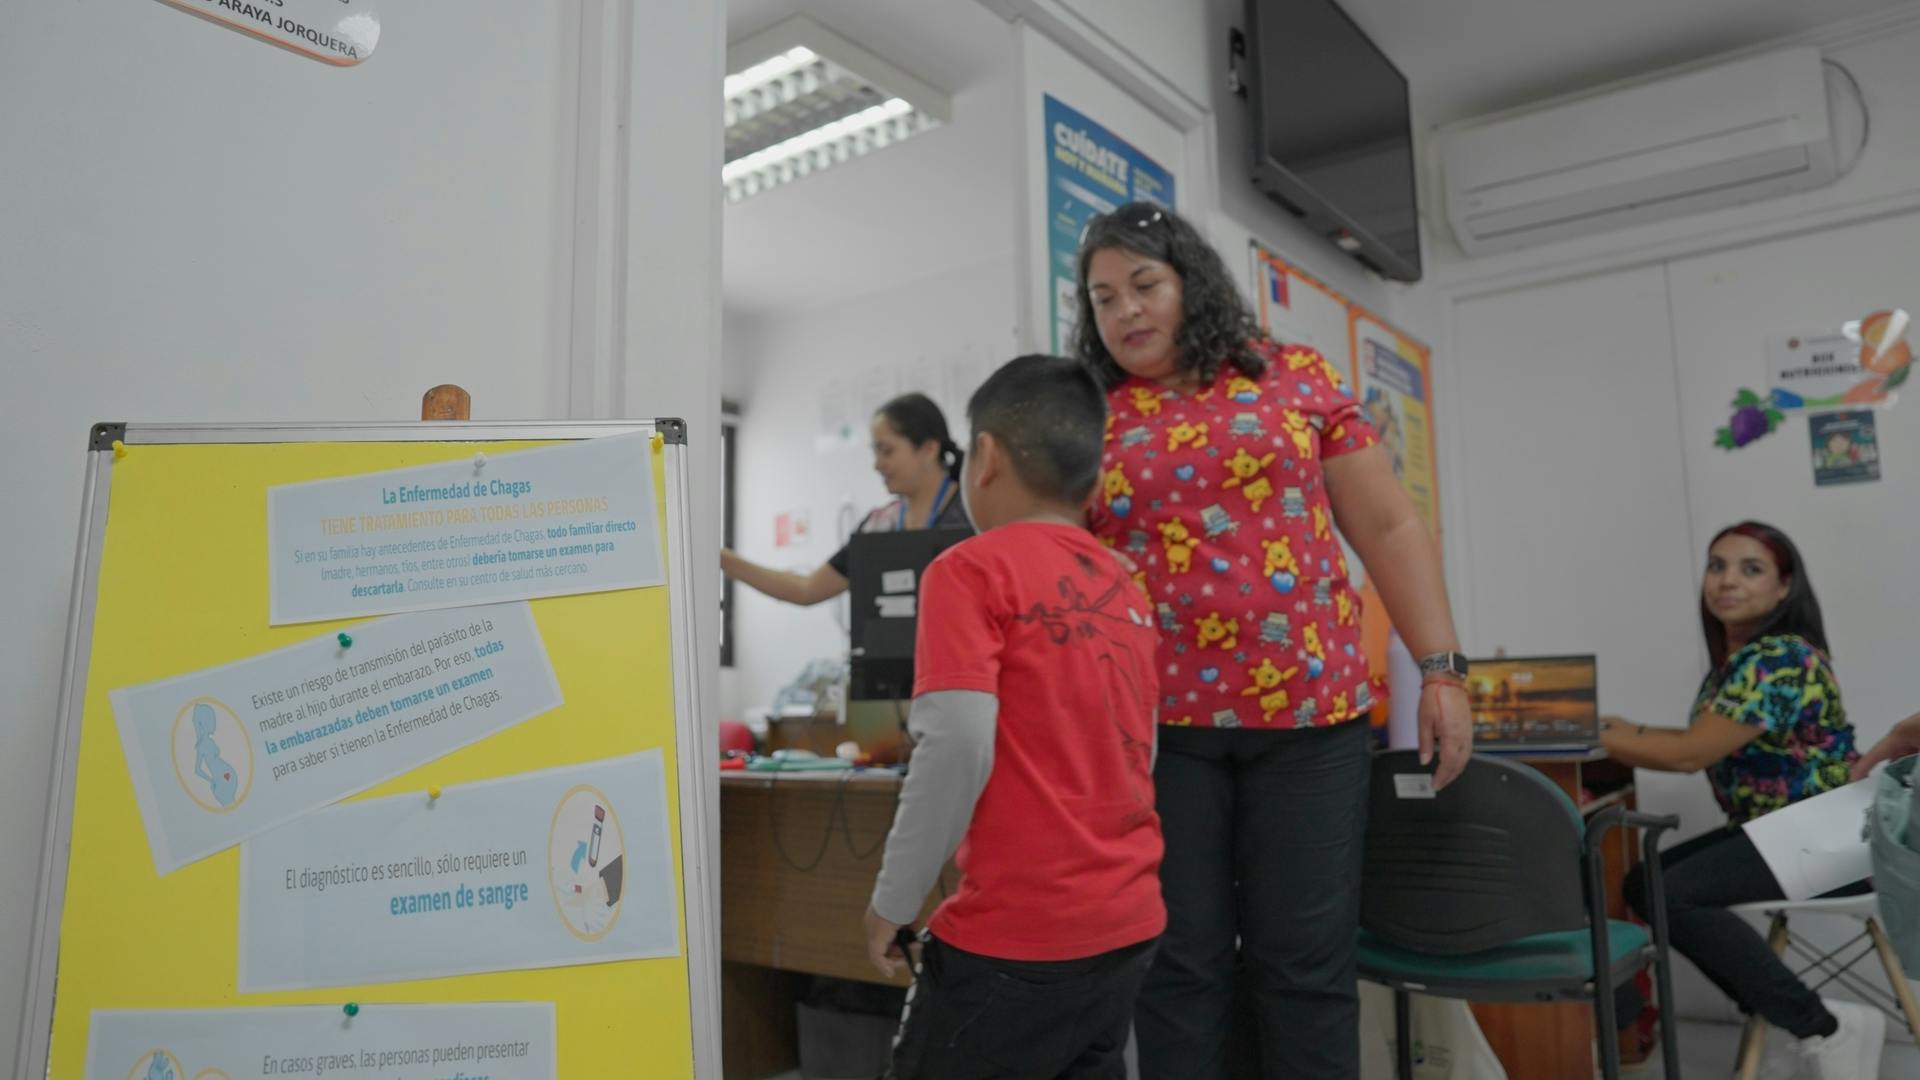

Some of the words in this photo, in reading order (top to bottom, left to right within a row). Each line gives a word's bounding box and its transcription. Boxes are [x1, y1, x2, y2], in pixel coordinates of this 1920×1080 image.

[218, 0, 272, 25] ARAYA
[276, 17, 358, 59] JORQUERA
[383, 488, 396, 504] La
[400, 482, 469, 503] Enfermedad
[473, 481, 488, 497] de
[490, 479, 531, 500] Chagas
[321, 518, 356, 536] TIENE
[360, 510, 444, 532] TRATAMIENTO
[447, 508, 478, 525] PARA
[480, 504, 520, 522] TODAS
[522, 502, 544, 517] LAS
[548, 497, 609, 516] PERSONAS
[294, 550, 303, 564] Si
[305, 552, 316, 563] en
[318, 551, 328, 562] su
[329, 545, 359, 560] familia
[361, 545, 377, 560] hay
[378, 538, 435, 555] antecedentes
[437, 536, 448, 550] de
[450, 531, 500, 549] Enfermedad
[502, 531, 513, 543] de
[547, 525, 567, 539] todo
[569, 521, 603, 537] familiar
[605, 520, 636, 533] directo
[421, 559, 444, 571] entre
[472, 551, 506, 566] debería
[508, 548, 544, 562] tomarse
[546, 548, 557, 558] un
[559, 543, 594, 556] examen
[595, 541, 614, 555] para
[408, 576, 445, 592] Consulte
[447, 578, 457, 588] en
[458, 576, 469, 587] su
[470, 571, 497, 585] centro
[499, 568, 510, 582] de
[512, 565, 534, 580] salud
[536, 564, 553, 577] más
[251, 690, 284, 710] Existe
[285, 685, 300, 699] un
[301, 673, 334, 694] riesgo
[335, 668, 348, 682] de
[349, 645, 409, 678] transmisión
[410, 640, 427, 657] del
[427, 628, 467, 654] parásito
[468, 622, 482, 637] de
[481, 619, 493, 632] la
[259, 711, 294, 732] madre
[295, 705, 306, 721] al
[306, 700, 327, 717] hijo
[329, 685, 369, 710] durante
[370, 680, 382, 695] el
[434, 657, 451, 672] Por
[474, 640, 504, 658] todas
[265, 740, 278, 755] la
[280, 716, 354, 750] embarazadas
[355, 704, 390, 724] deben
[390, 687, 435, 712] tomarse
[435, 683, 450, 696] un
[451, 667, 494, 690] examen
[272, 759, 298, 781] para
[299, 749, 327, 769] saber
[329, 747, 340, 759] si
[340, 733, 375, 755] tienen
[375, 729, 386, 743] la
[385, 705, 448, 739] Enfermedad
[449, 701, 462, 716] de
[285, 868, 297, 890] El
[299, 860, 368, 893] diagnóstico
[371, 864, 385, 881] es
[387, 855, 434, 880] sencillo,
[436, 851, 461, 873] sólo
[463, 850, 509, 874] requiere
[510, 850, 527, 866] un
[390, 892, 451, 916] examen
[455, 883, 475, 908] de
[478, 881, 529, 910] sangre
[263, 1055, 278, 1074] En
[280, 1056, 314, 1074] casos
[359, 1048, 376, 1068] las
[379, 1048, 430, 1071] personas
[432, 1042, 475, 1067] pueden
[477, 1040, 530, 1063] presentar
